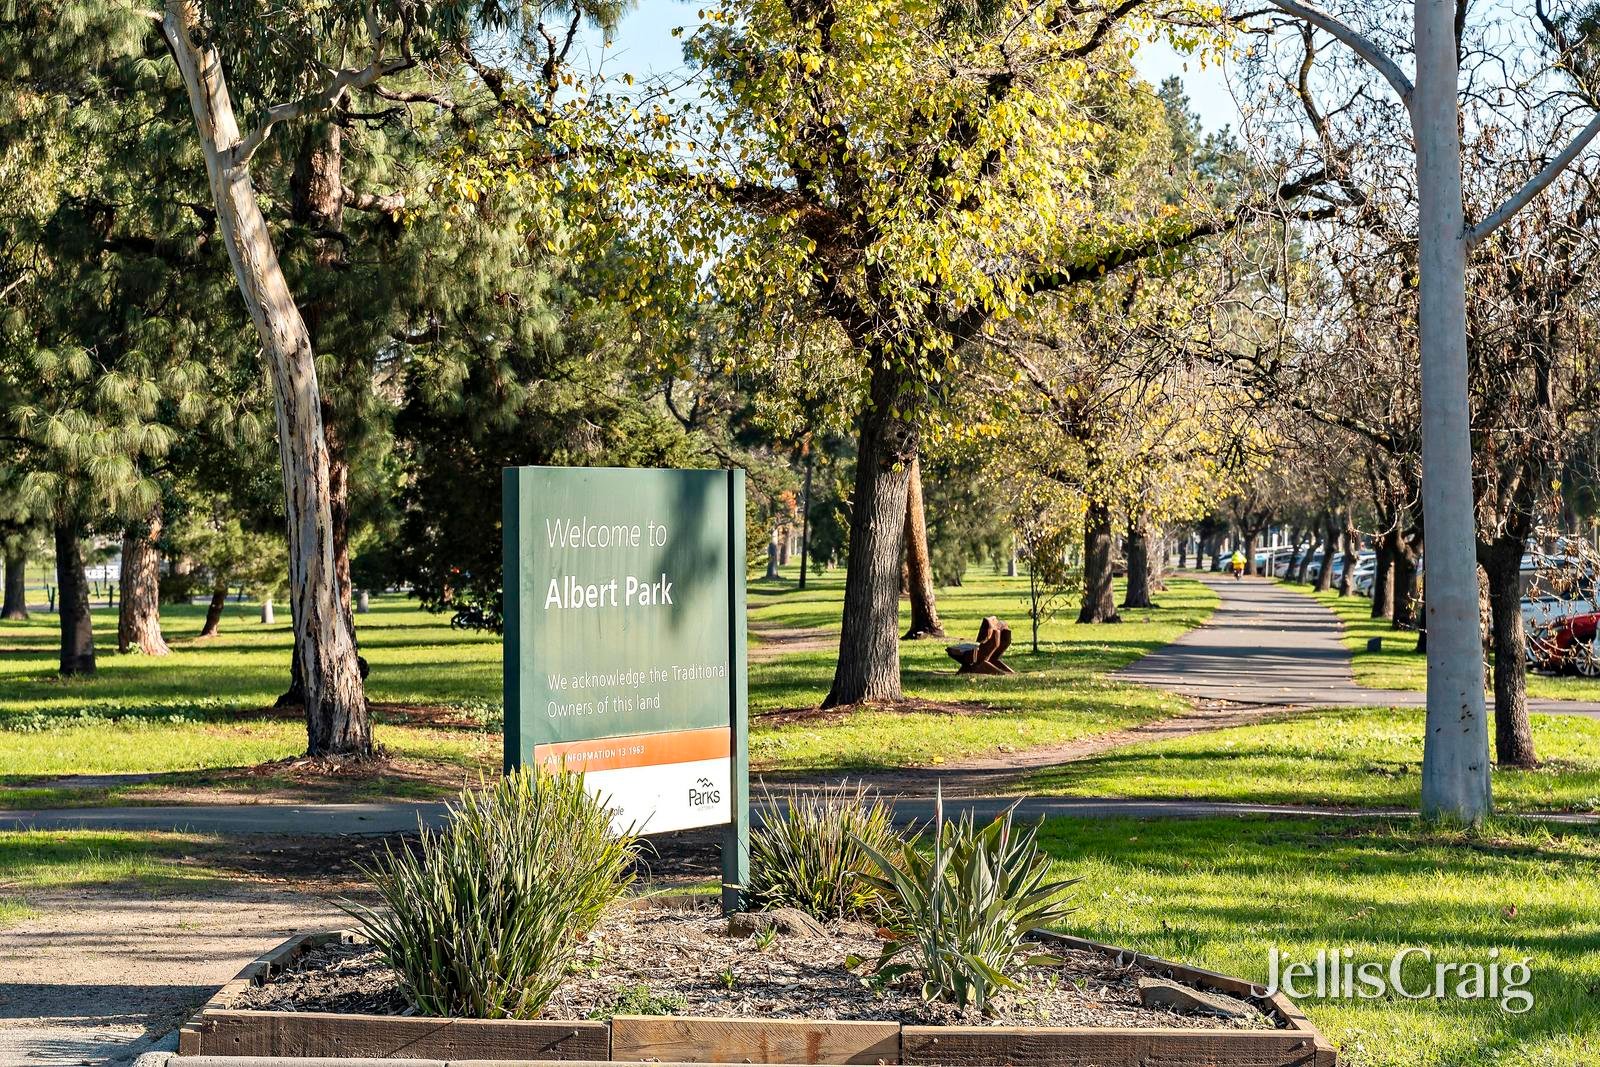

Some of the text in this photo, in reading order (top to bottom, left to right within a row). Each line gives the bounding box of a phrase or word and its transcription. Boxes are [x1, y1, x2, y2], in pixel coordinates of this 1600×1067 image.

[546, 516, 667, 548] Welcome to
[544, 573, 673, 610] Albert Park
[548, 661, 729, 690] We acknowledge the Traditional
[547, 692, 660, 718] Owners of this land
[618, 748, 626, 757] 13
[689, 788, 720, 807] Parks
